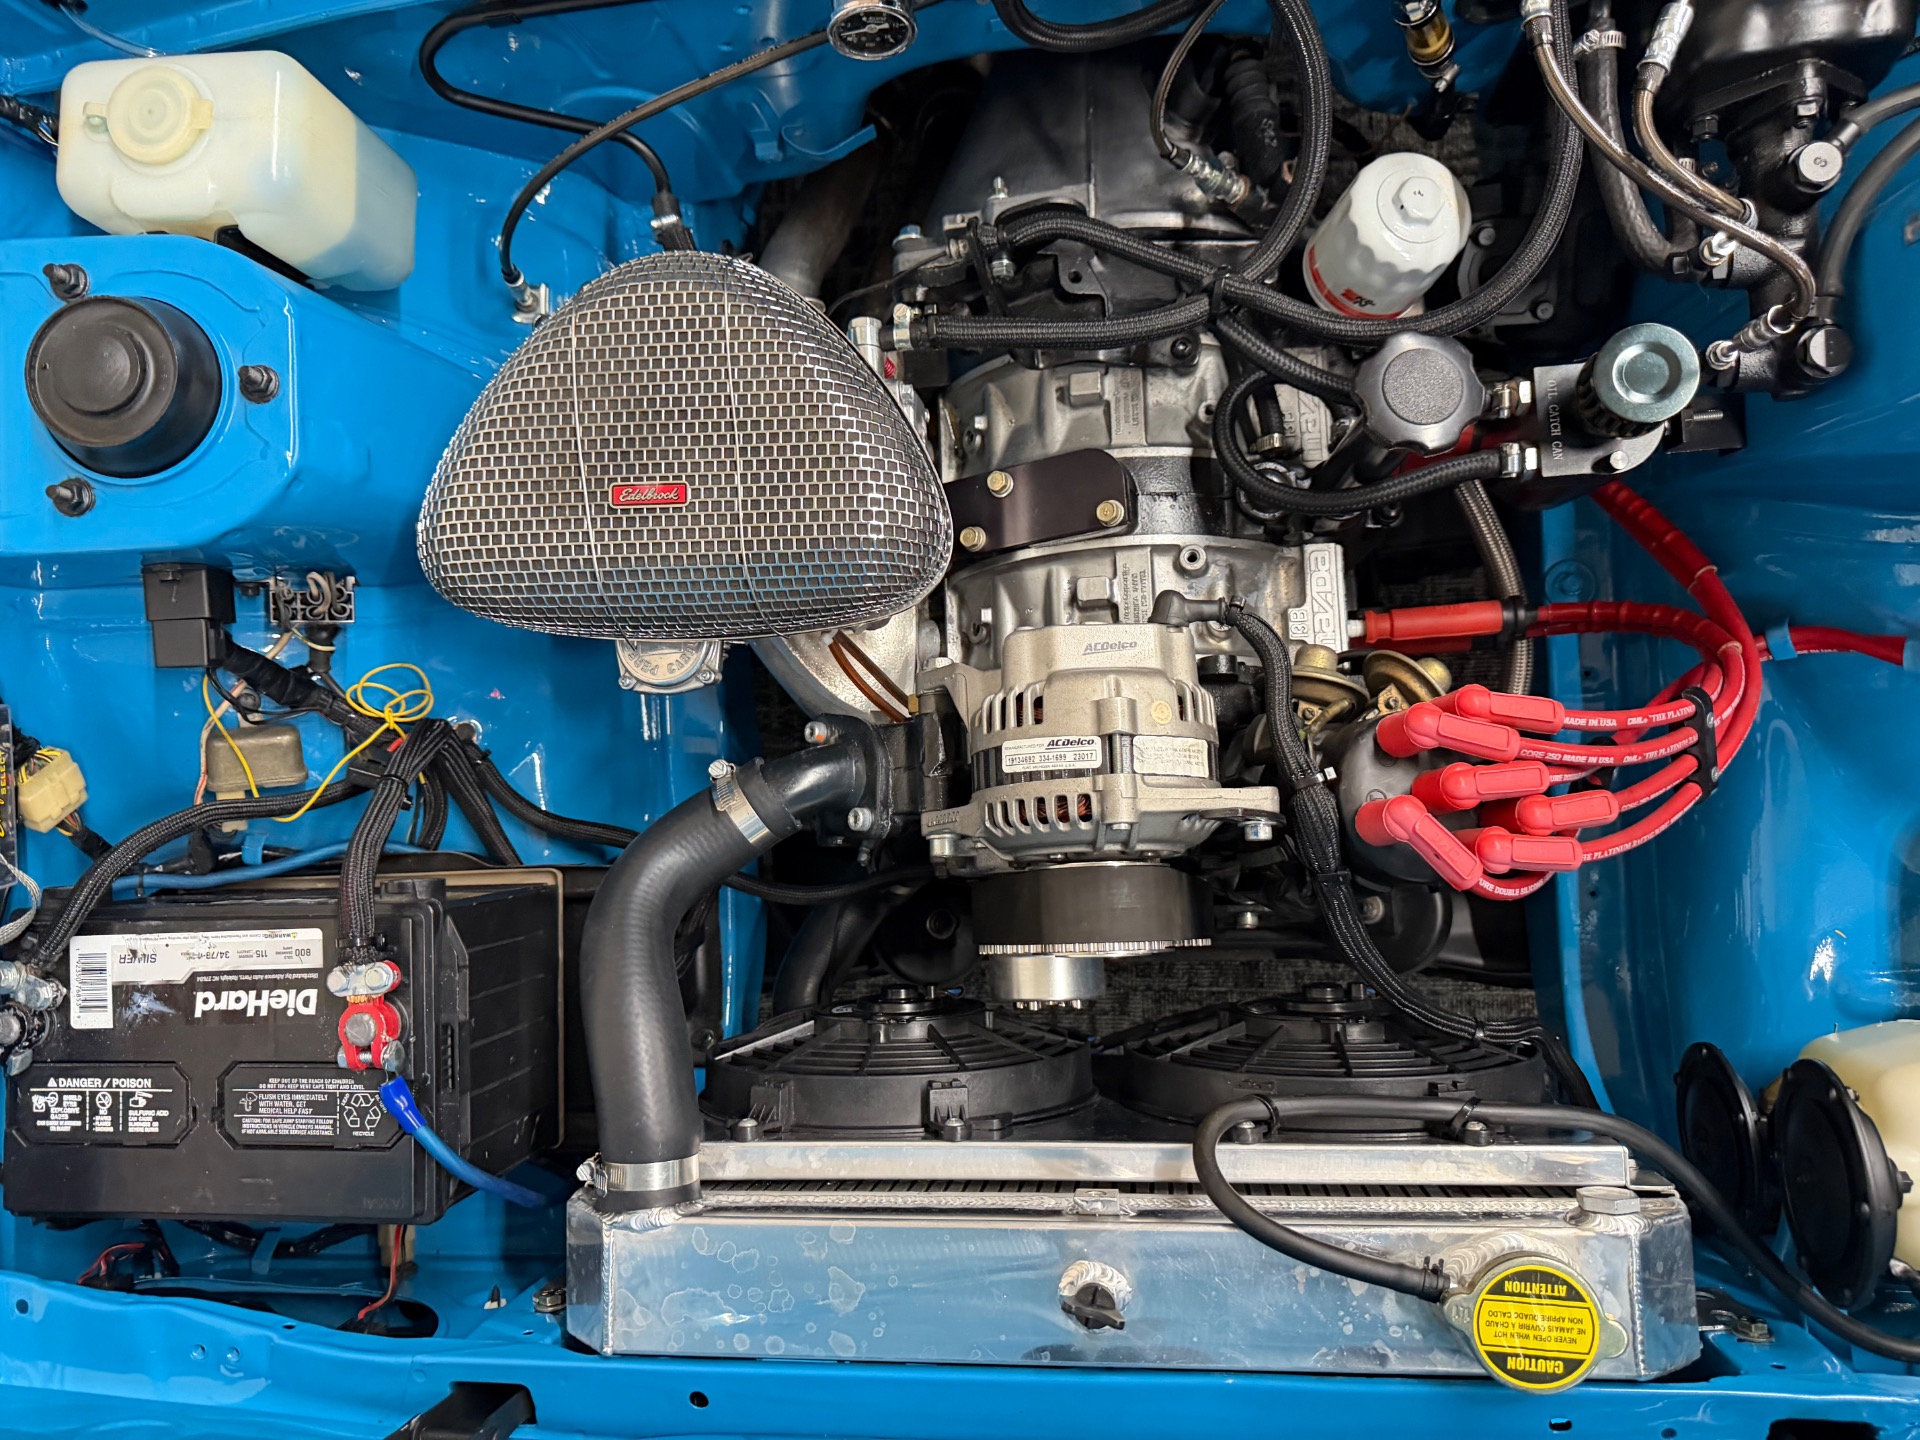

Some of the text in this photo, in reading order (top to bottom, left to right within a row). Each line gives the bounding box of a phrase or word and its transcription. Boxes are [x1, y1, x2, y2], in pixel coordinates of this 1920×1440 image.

[1547, 380, 1564, 460] OIL CATCH CAN
[620, 488, 679, 502] Edelbrock
[1290, 608, 1308, 640] 13B
[1084, 641, 1138, 654] ACDelco
[1564, 716, 1586, 726] MADE
[1046, 738, 1094, 748] ACDelco
[1073, 752, 1094, 760] 23017
[1520, 750, 1545, 759] CORE
[1562, 754, 1586, 763] MADE
[1593, 841, 1632, 860] PLATINUM
[1494, 886, 1520, 896] DOUBLE
[256, 950, 267, 958] 115
[194, 988, 318, 1018] DieHard
[59, 1078, 102, 1088] DANGER
[112, 1078, 151, 1088] POISON
[1505, 1281, 1567, 1296] ATTENTION
[1488, 1310, 1512, 1318] CALDO
[1541, 1315, 1566, 1323] APRIRE
[1485, 1320, 1510, 1328] CHAUD
[1518, 1322, 1545, 1332] OUVRIR
[1548, 1325, 1574, 1334] JAMAIS
[1510, 1332, 1530, 1340] WHEN
[1533, 1334, 1552, 1342] OPEN
[1554, 1336, 1577, 1344] NEVER
[1507, 1356, 1564, 1374] CAUTION
